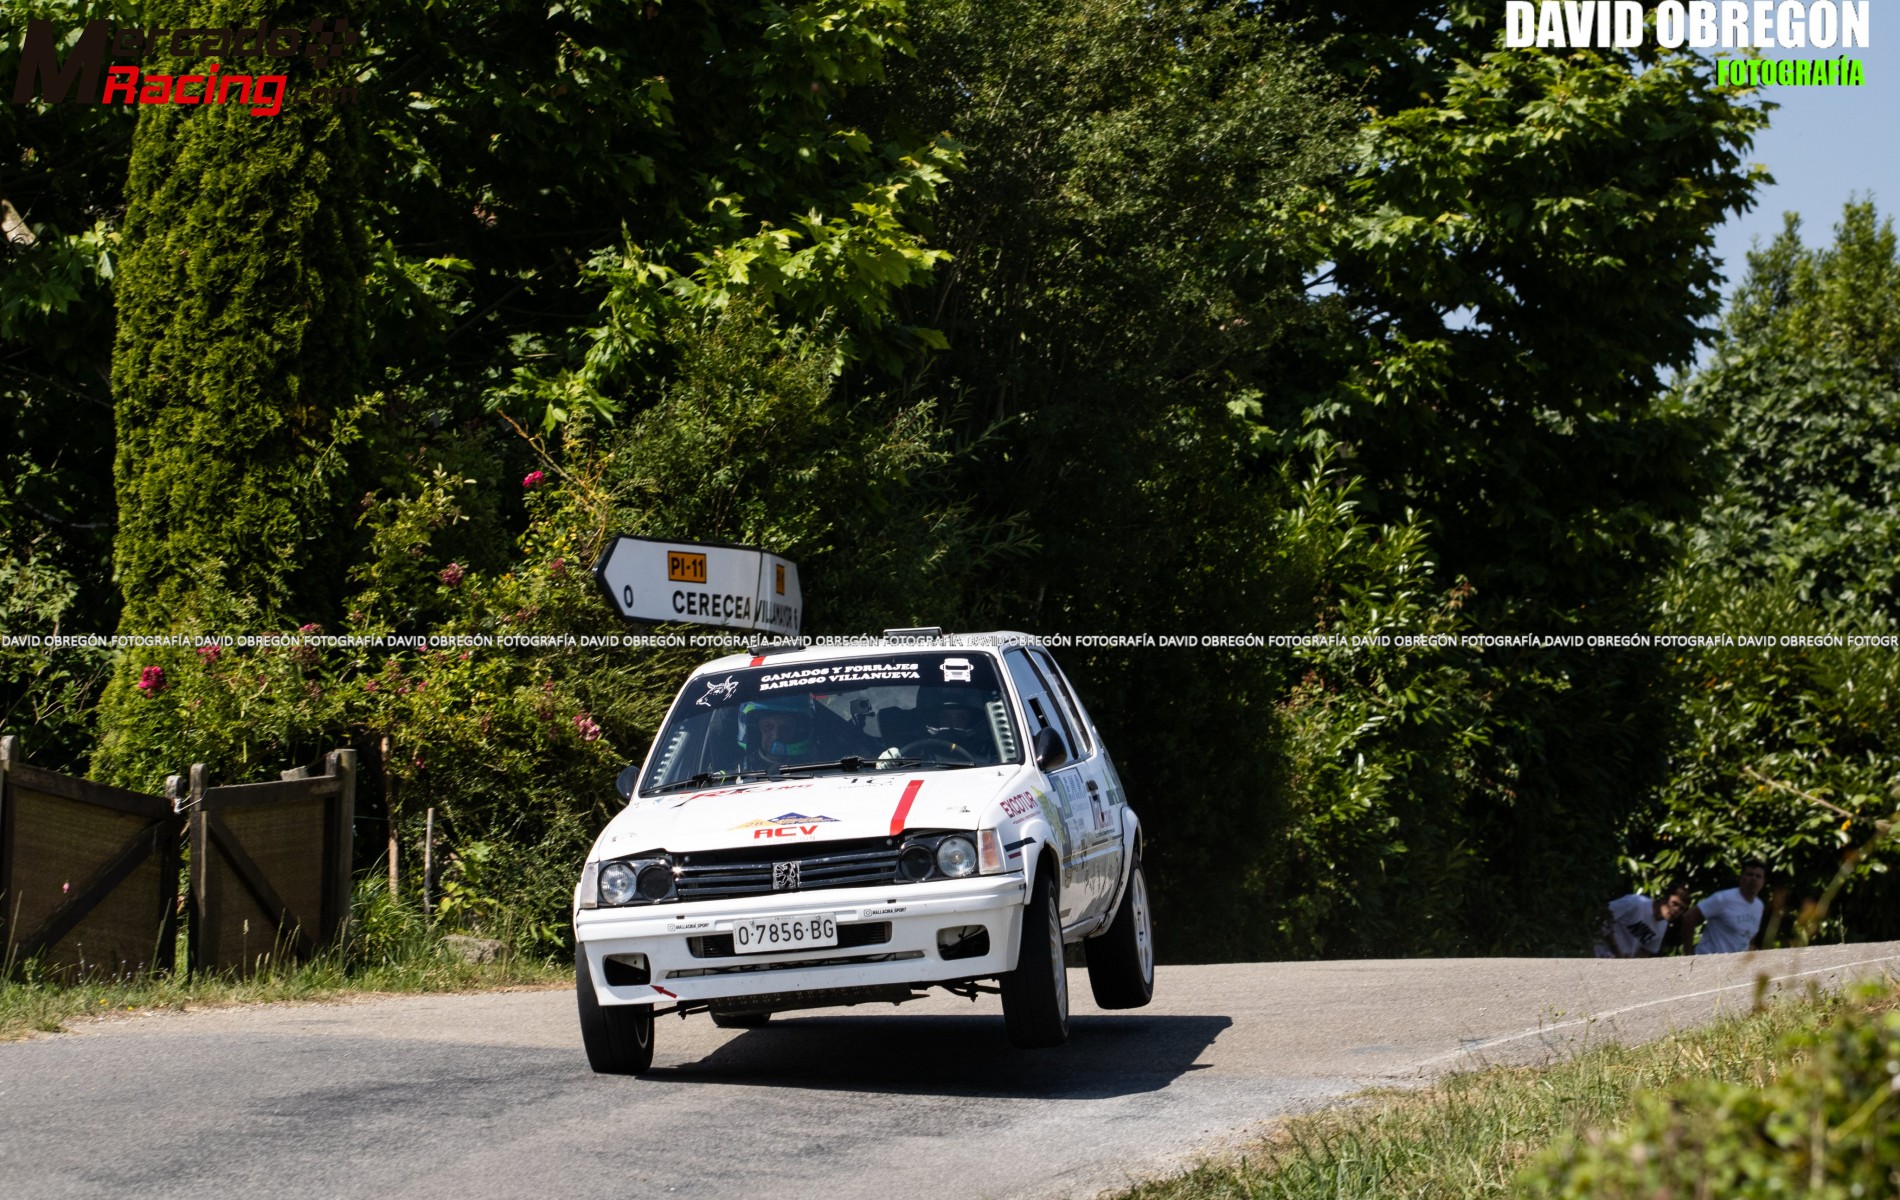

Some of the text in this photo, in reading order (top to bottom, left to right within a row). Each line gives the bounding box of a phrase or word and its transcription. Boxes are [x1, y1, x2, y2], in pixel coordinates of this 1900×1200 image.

[671, 557, 704, 578] PI-11
[672, 590, 751, 620] CERECEA
[760, 671, 920, 691] BARROSO VILLANUEVA
[761, 663, 919, 683] GANADOS Y FORRAJES
